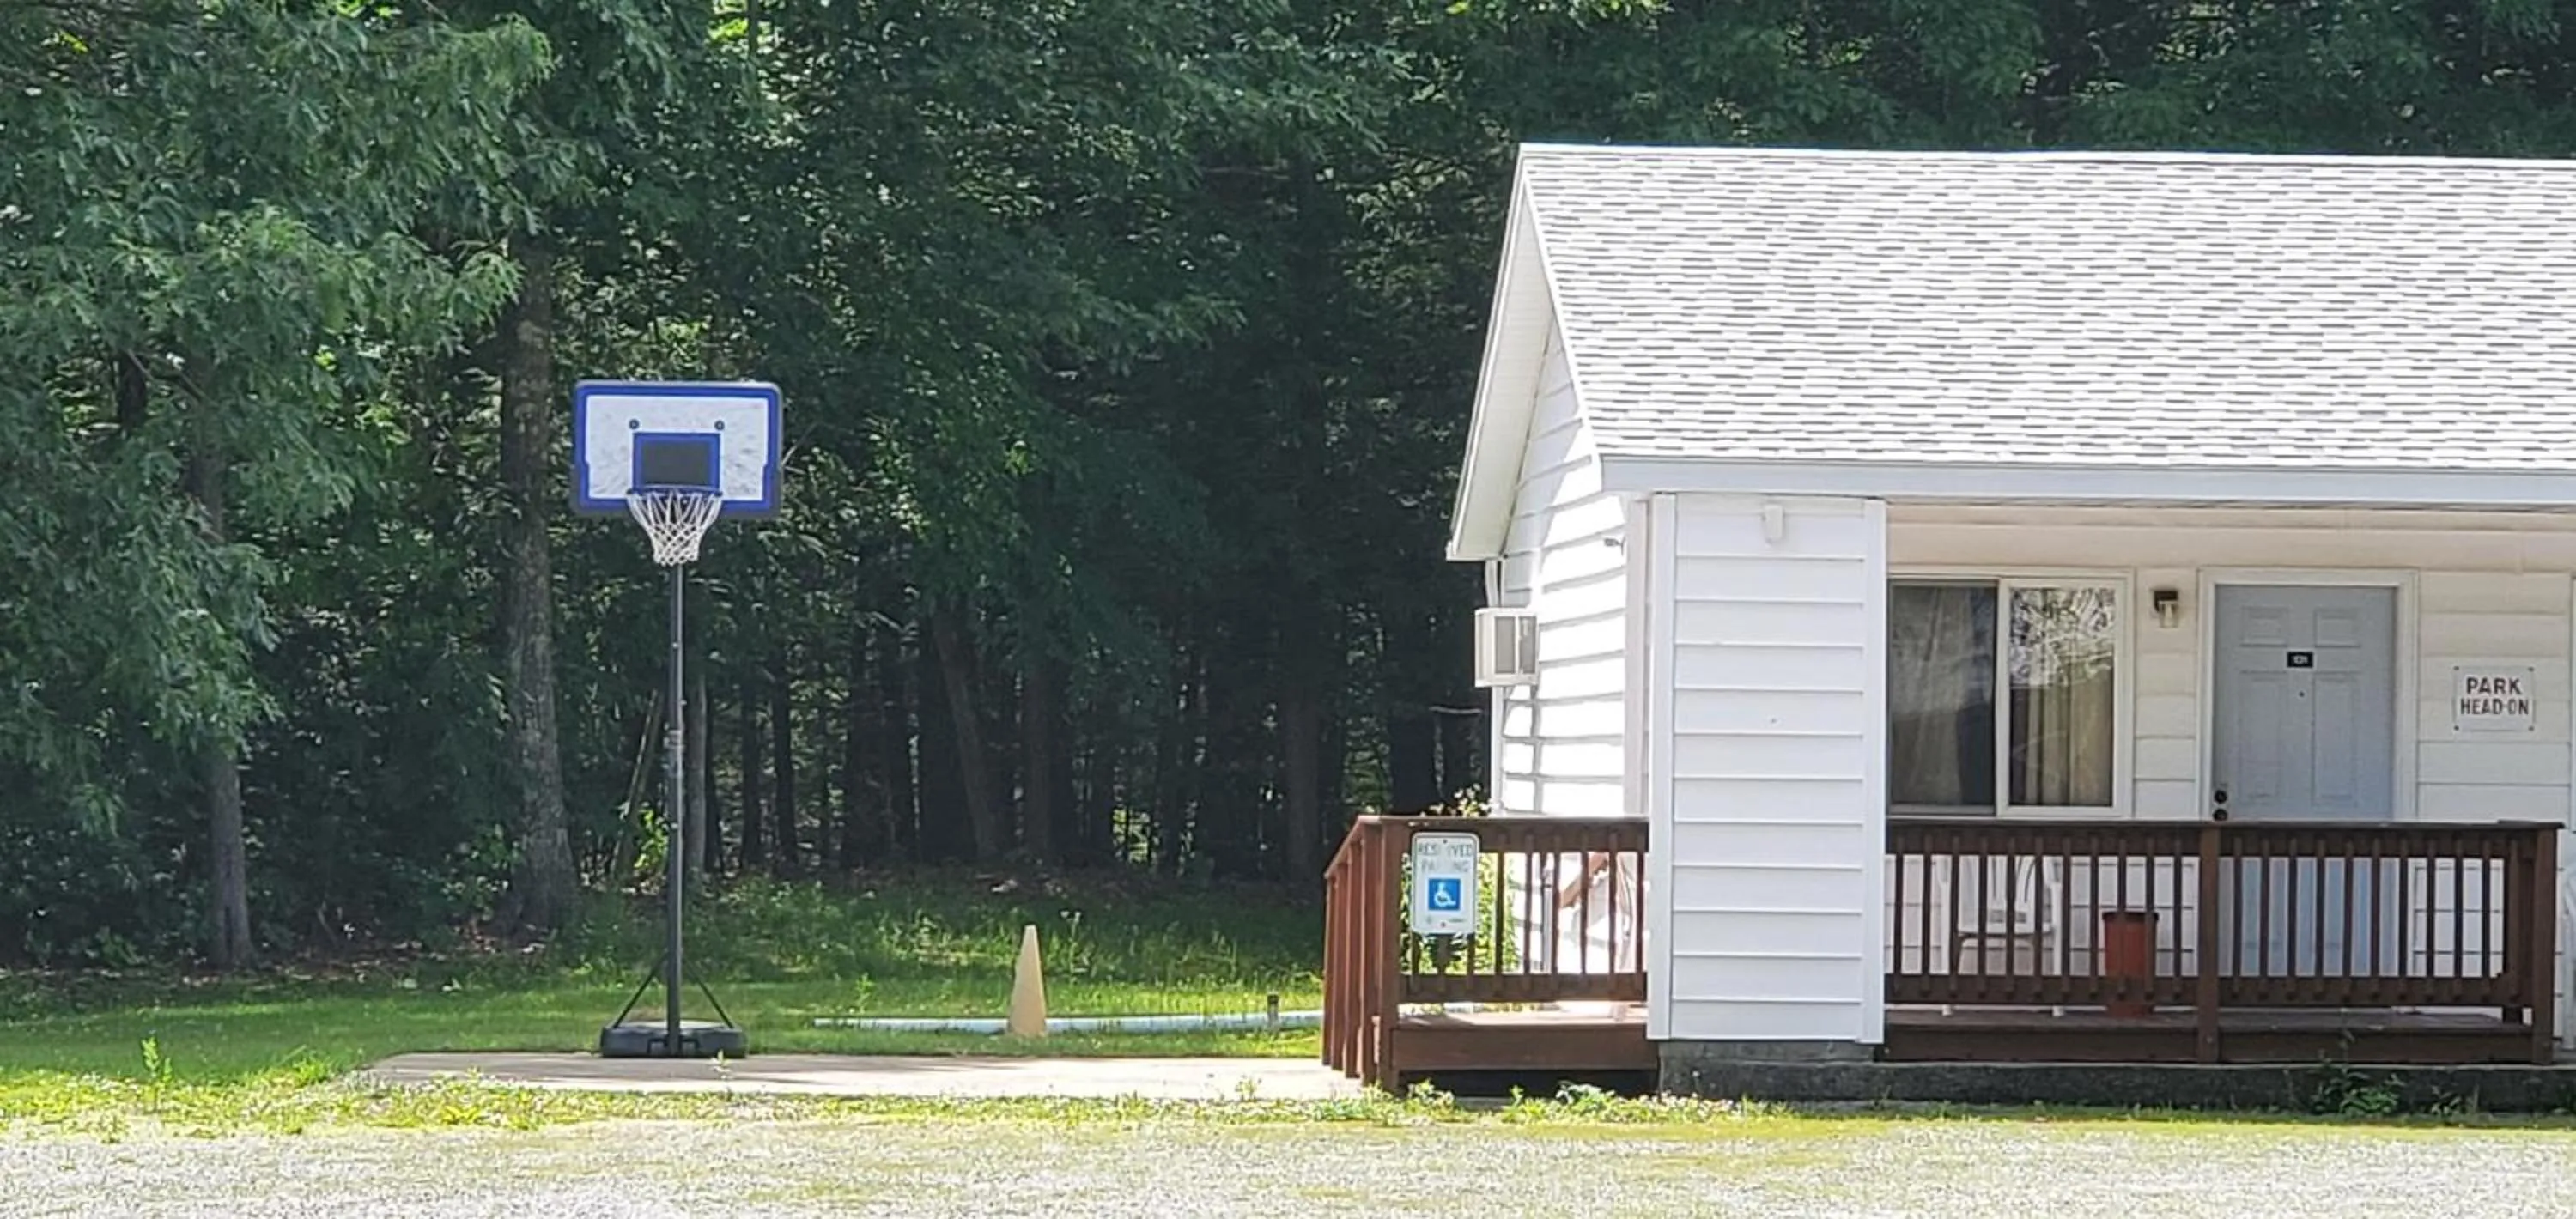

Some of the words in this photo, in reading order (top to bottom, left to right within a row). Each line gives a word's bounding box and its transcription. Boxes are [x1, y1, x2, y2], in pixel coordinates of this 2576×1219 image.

[2466, 676, 2522, 694] PARK
[1418, 843, 1473, 858] RESVED
[1421, 858, 1470, 872] PANG
